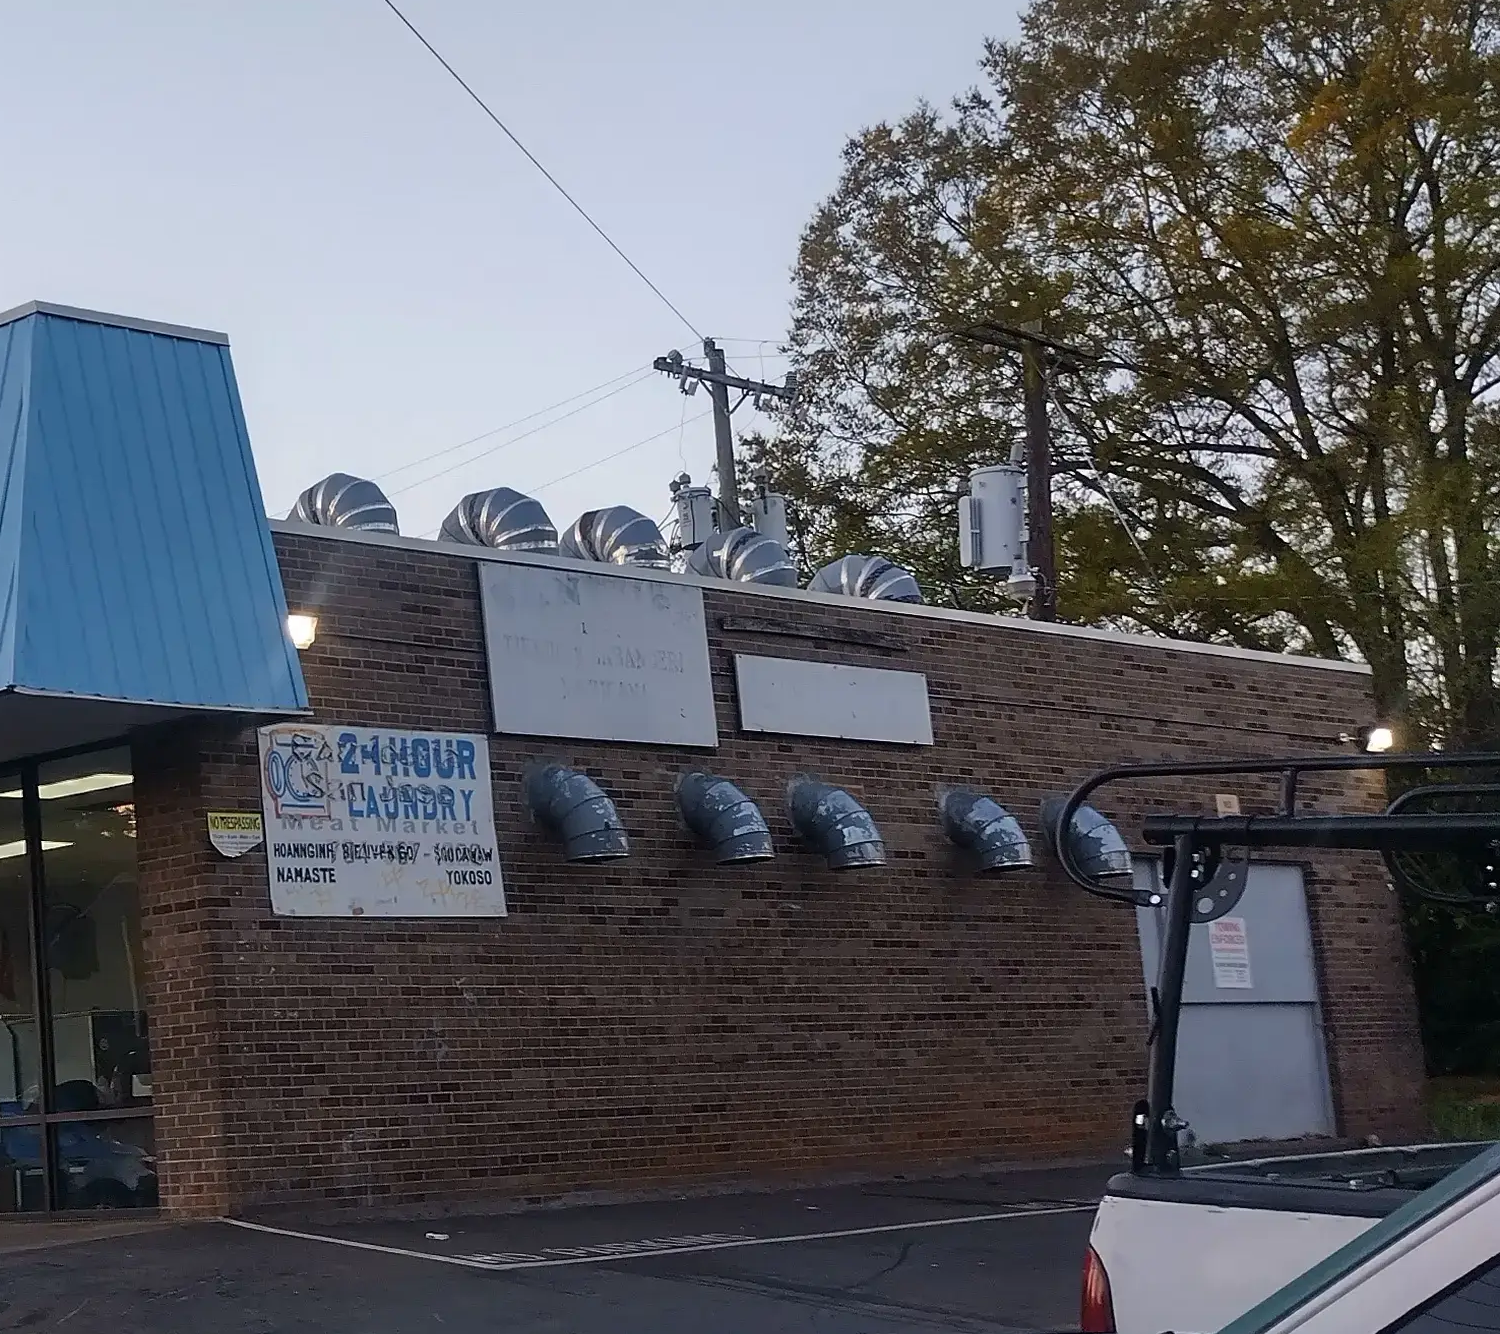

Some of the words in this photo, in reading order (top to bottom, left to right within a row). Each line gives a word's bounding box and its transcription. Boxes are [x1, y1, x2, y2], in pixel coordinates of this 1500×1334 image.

[390, 735, 477, 780] HOUR
[347, 785, 476, 822] LAUNDRY
[280, 816, 360, 834] Meat
[376, 817, 480, 836] Market
[276, 866, 337, 884] NAMASTE
[445, 869, 493, 886] YOKOSO
